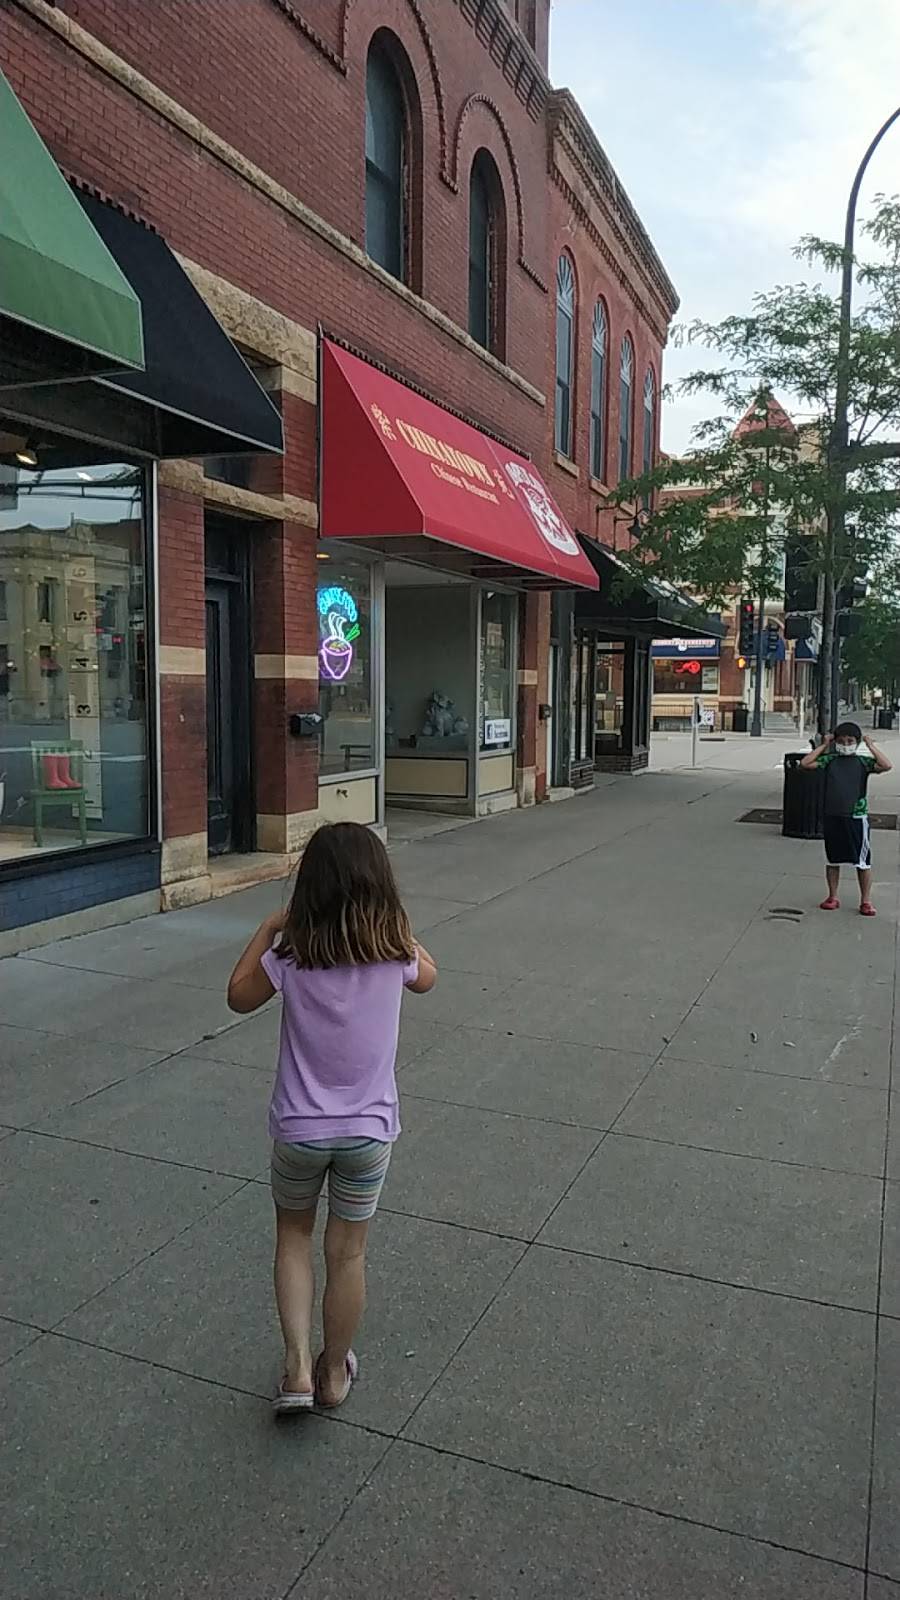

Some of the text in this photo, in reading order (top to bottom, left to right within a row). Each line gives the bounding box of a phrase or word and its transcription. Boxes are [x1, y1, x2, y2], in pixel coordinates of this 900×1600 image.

[73, 610, 87, 621] 5
[75, 657, 90, 668] 4
[77, 704, 91, 714] 3
